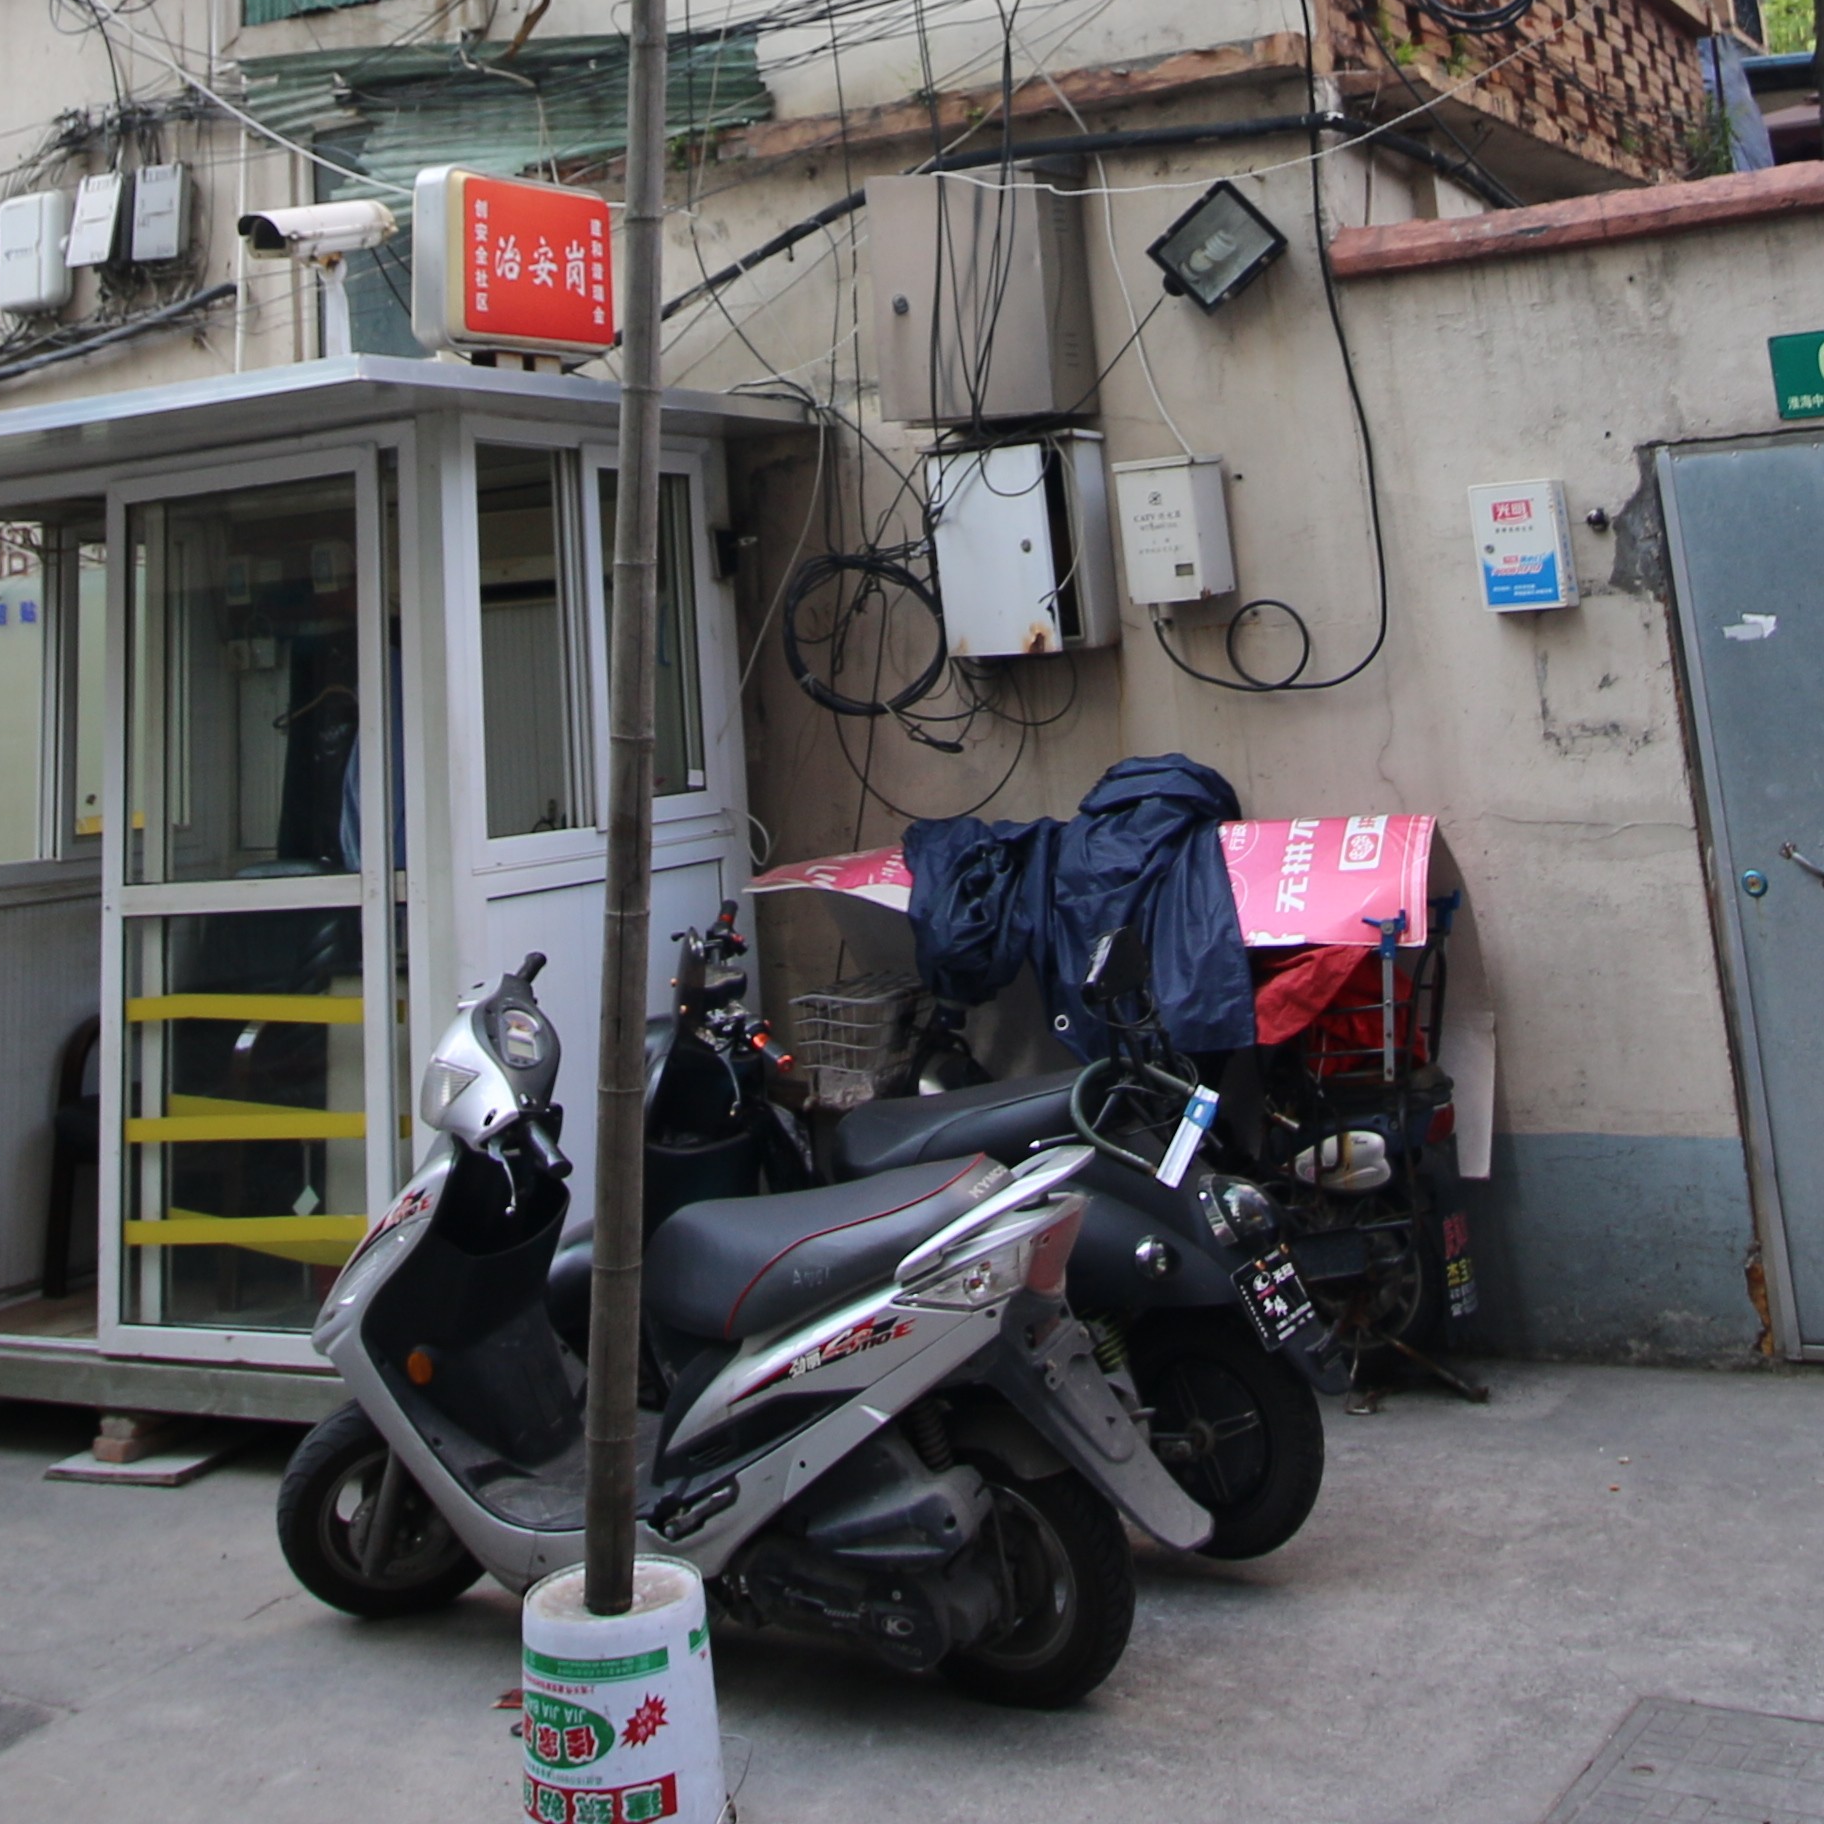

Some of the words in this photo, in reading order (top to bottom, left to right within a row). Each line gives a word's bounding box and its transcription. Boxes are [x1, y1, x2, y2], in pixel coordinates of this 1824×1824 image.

[474, 198, 489, 312] 创安全社区
[494, 233, 586, 298] 治安岗
